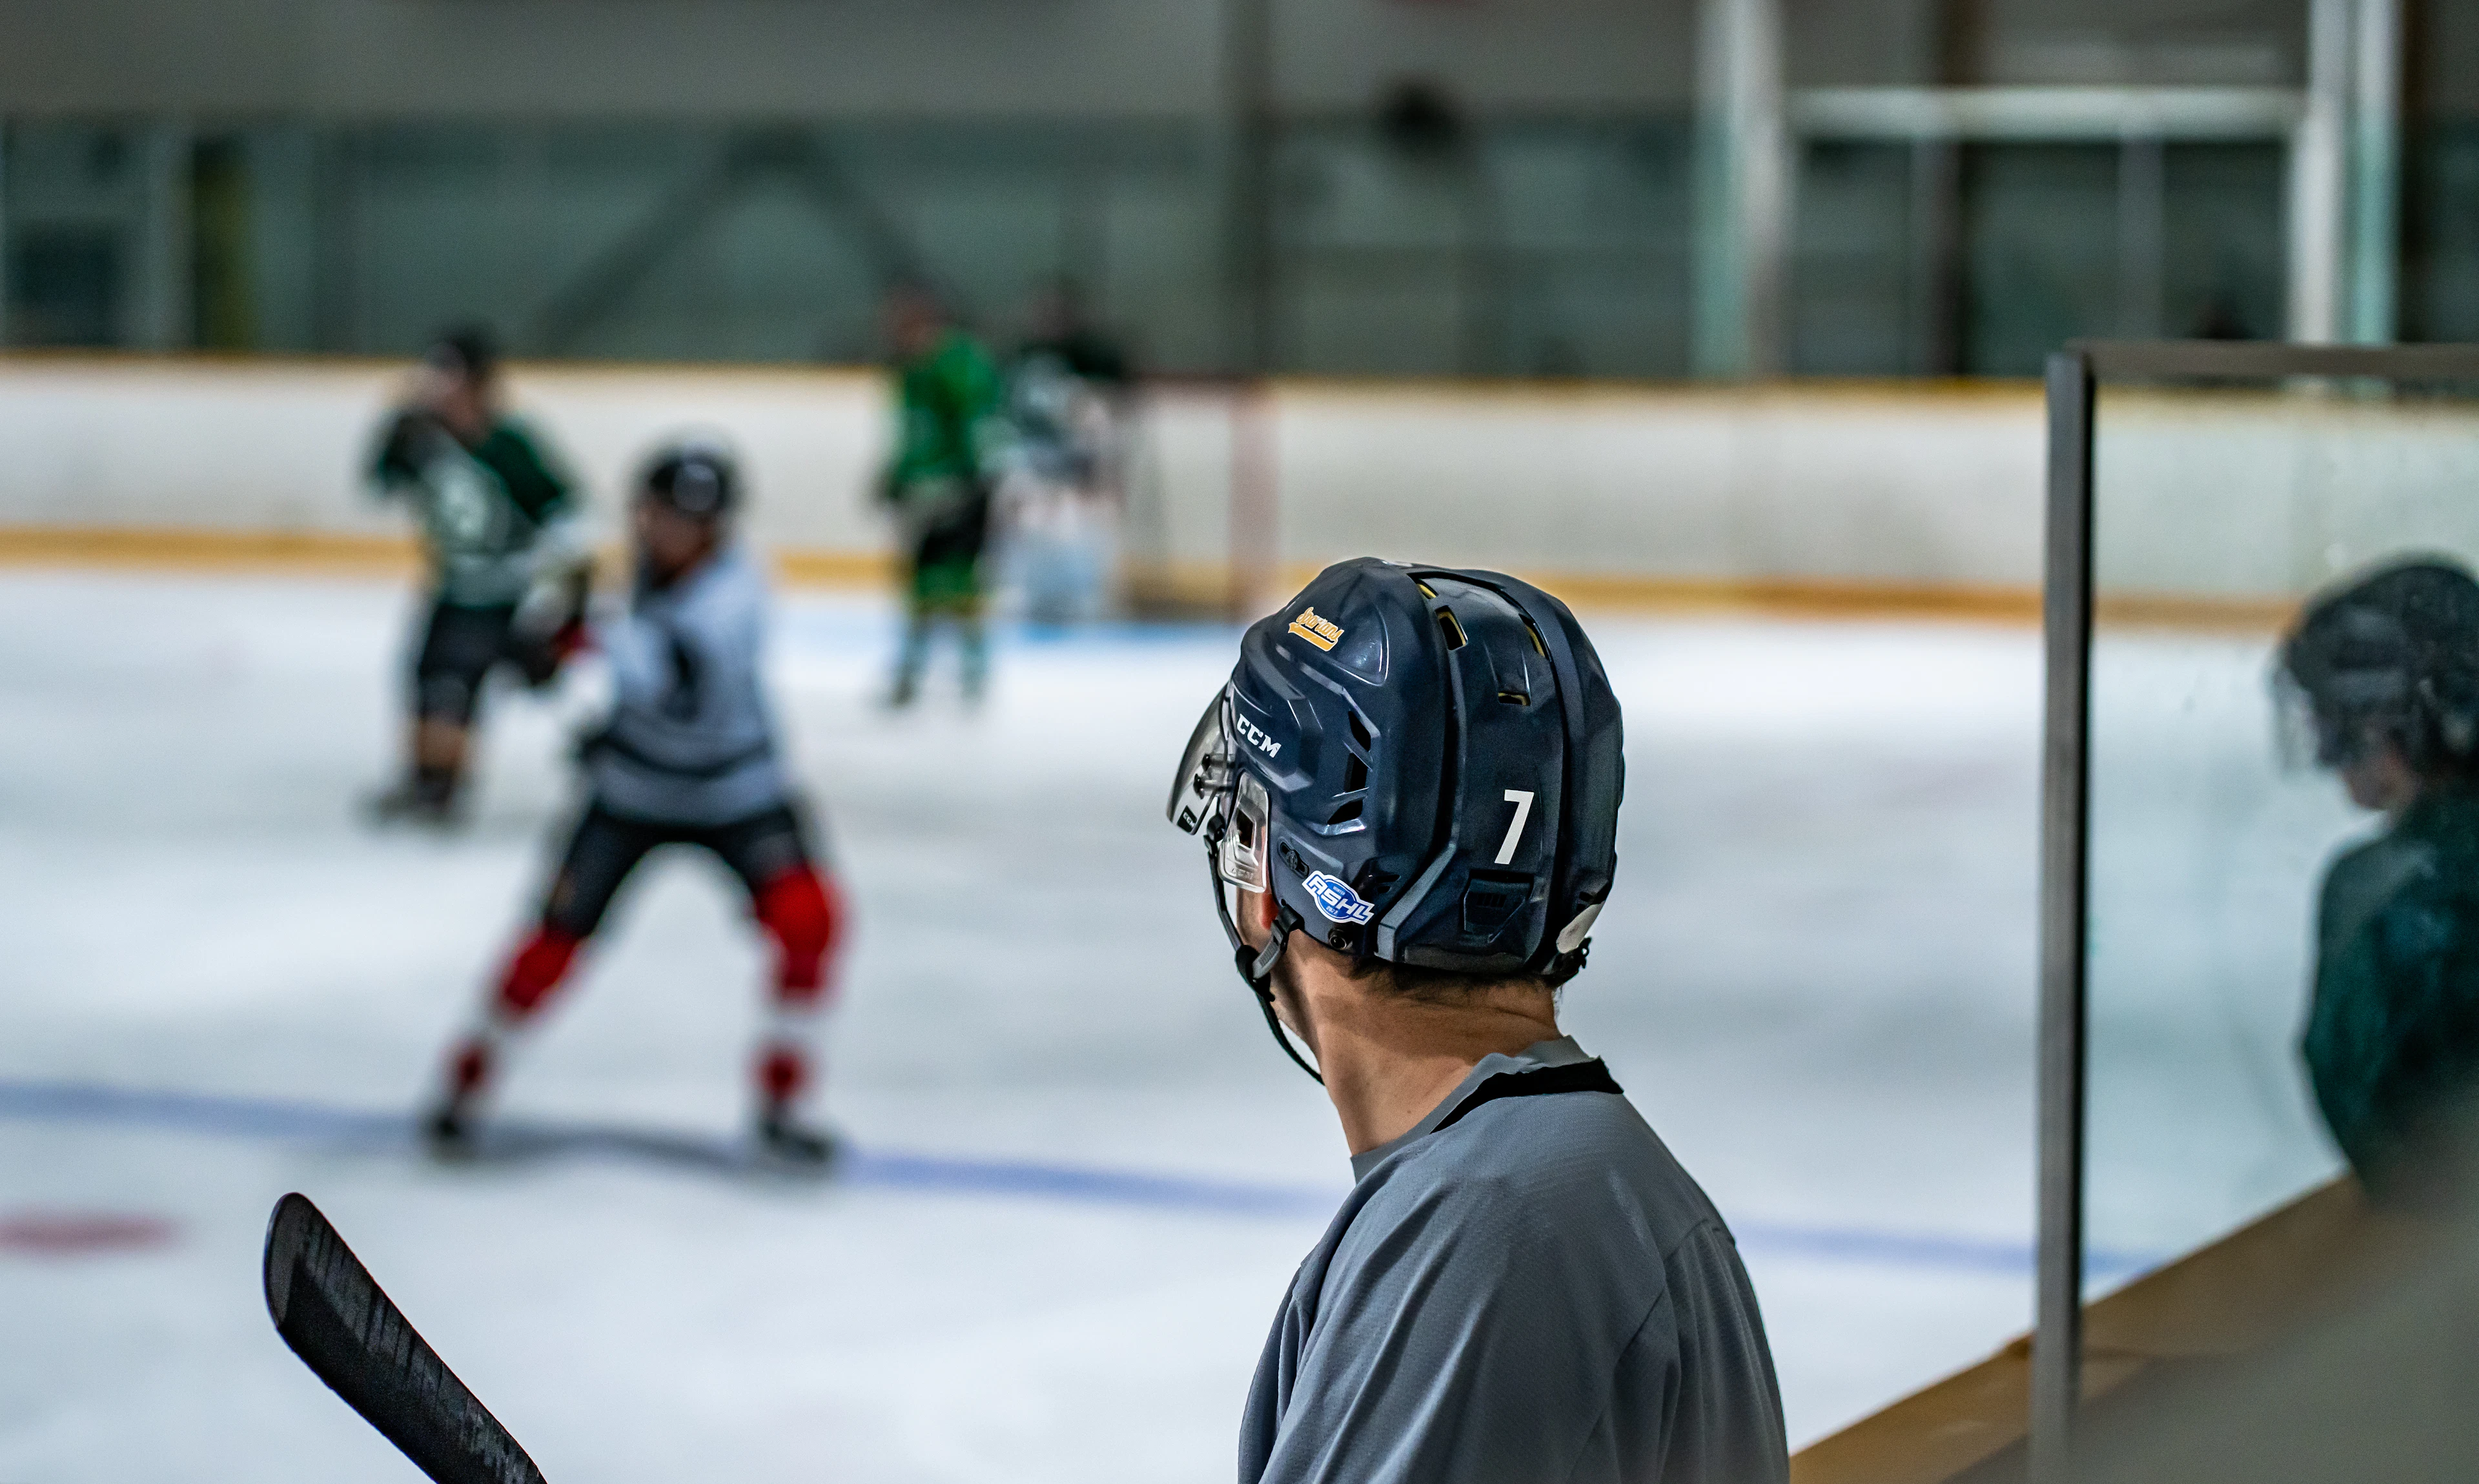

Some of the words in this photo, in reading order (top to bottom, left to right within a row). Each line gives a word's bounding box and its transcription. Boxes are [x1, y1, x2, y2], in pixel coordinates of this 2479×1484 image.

[1237, 713, 1281, 758] CCM
[1495, 789, 1534, 864] 7
[1307, 876, 1368, 920] ASHL
